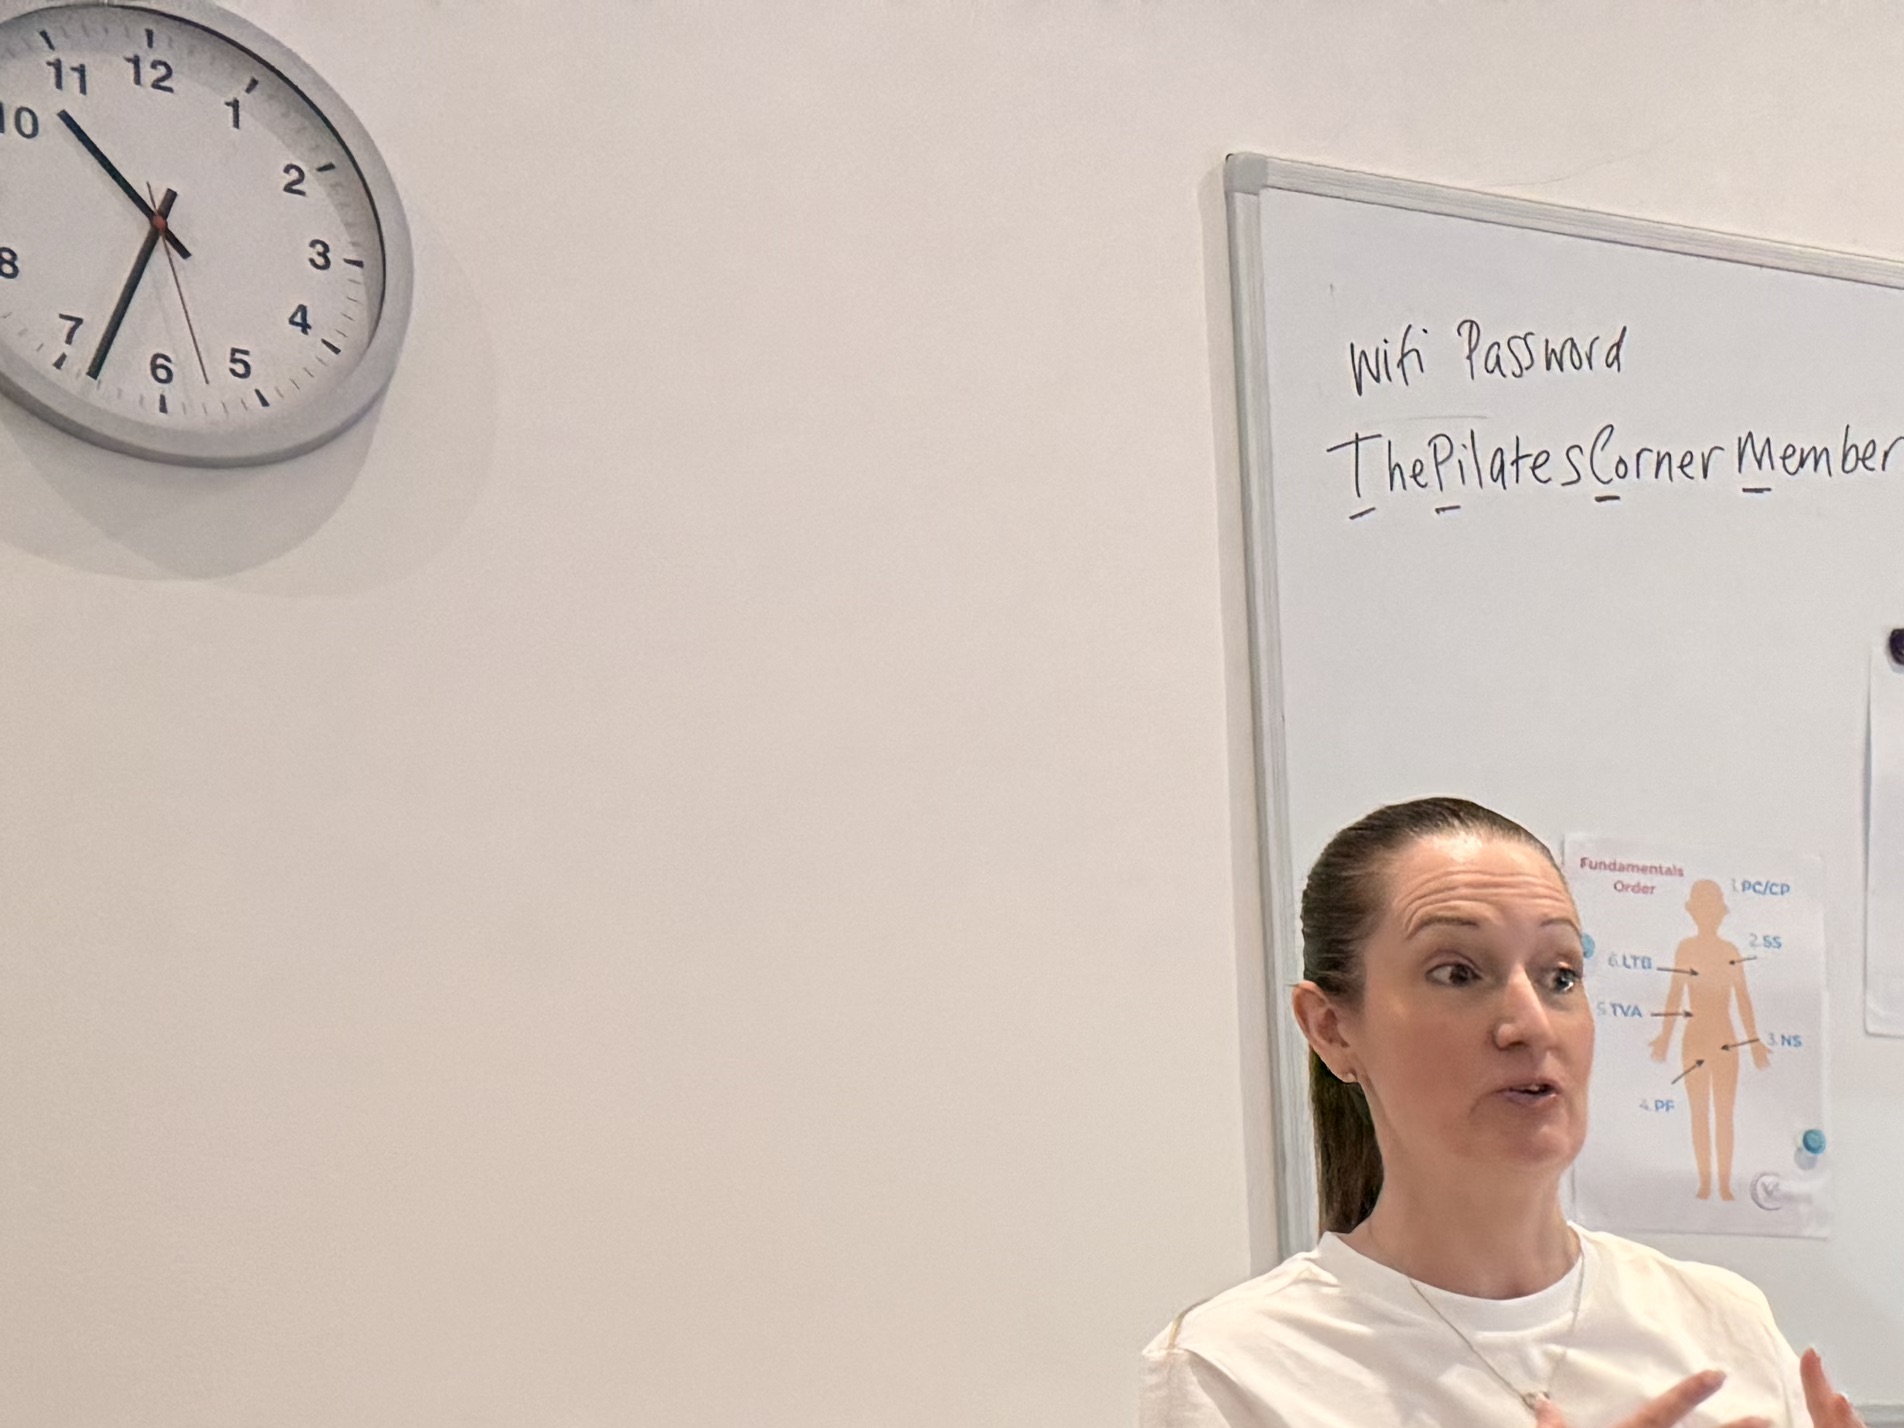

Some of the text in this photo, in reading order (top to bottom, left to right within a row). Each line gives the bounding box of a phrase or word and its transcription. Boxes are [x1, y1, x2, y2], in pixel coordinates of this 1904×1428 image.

[46, 57, 87, 95] 11
[124, 55, 175, 93] 12
[224, 97, 240, 129] 1
[283, 163, 306, 195] 2
[308, 239, 331, 270] 3
[59, 313, 84, 345] 7
[288, 304, 312, 334] 4
[229, 347, 251, 379] 5
[1456, 320, 1628, 380] Password
[150, 352, 173, 384] 6
[1579, 856, 1684, 878] Fundamentals
[1613, 880, 1656, 896] Order
